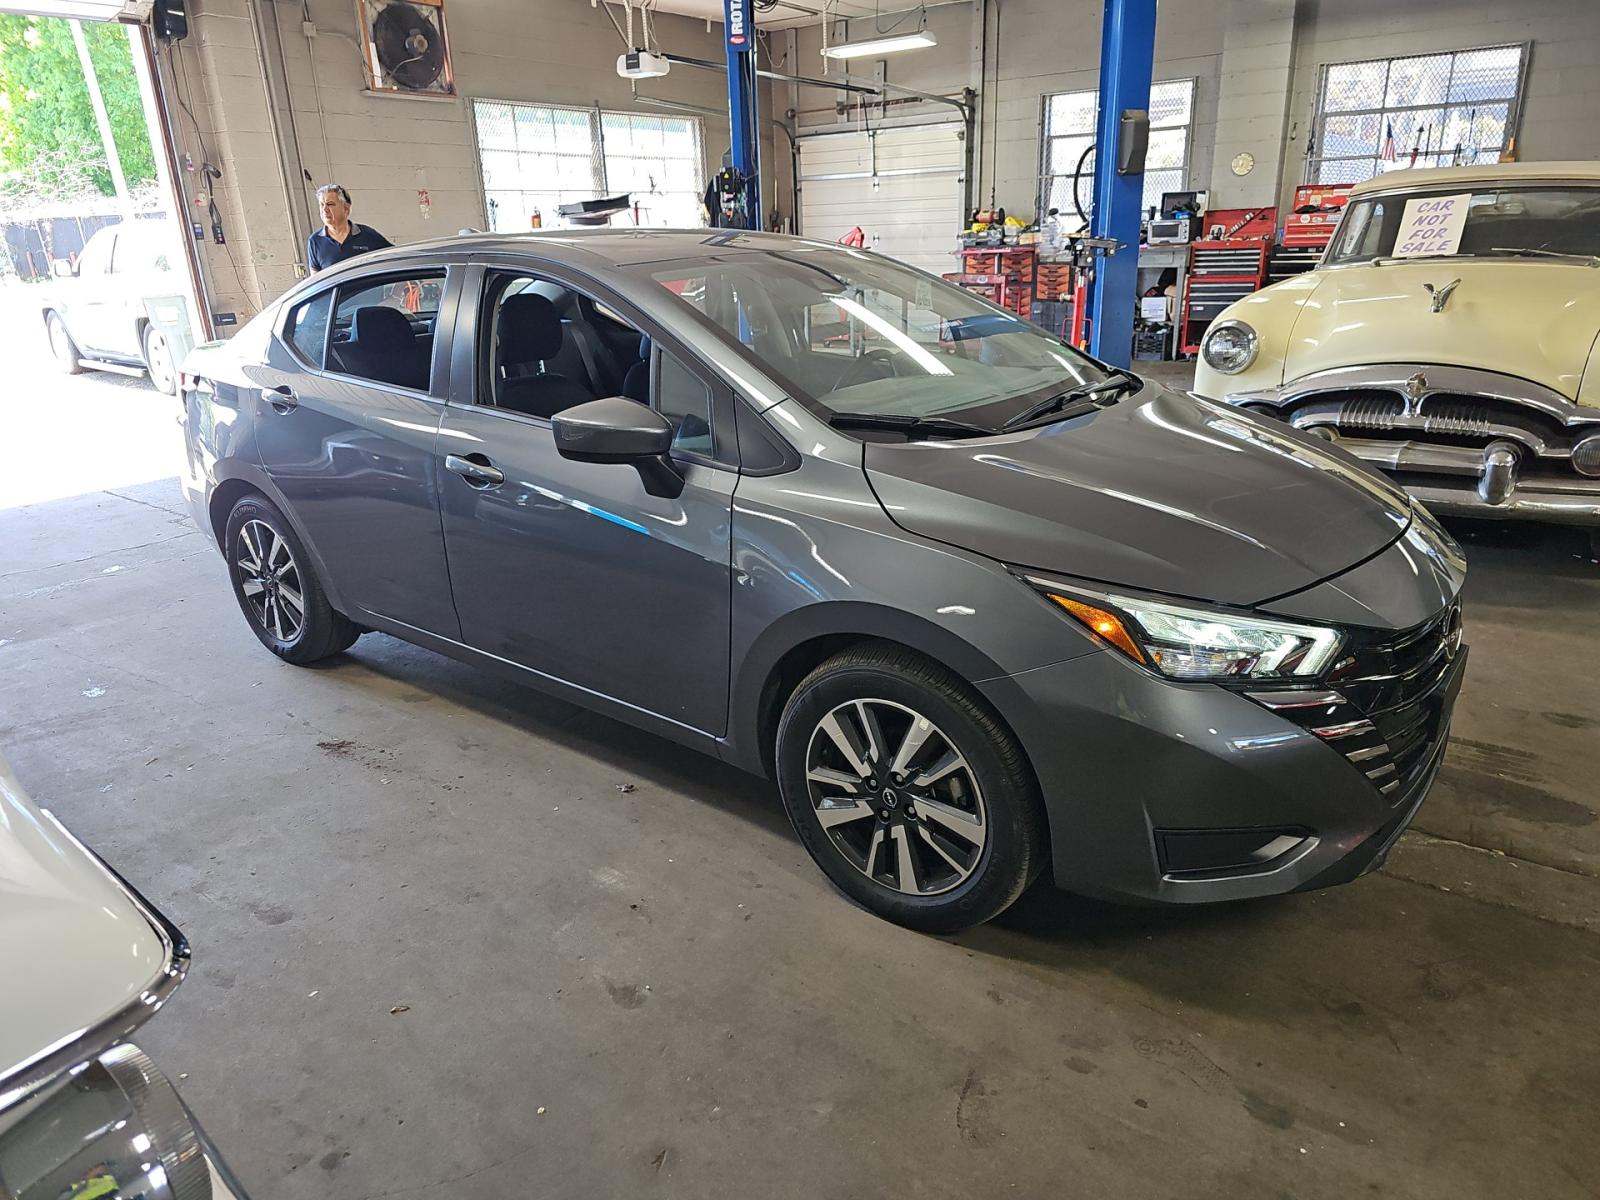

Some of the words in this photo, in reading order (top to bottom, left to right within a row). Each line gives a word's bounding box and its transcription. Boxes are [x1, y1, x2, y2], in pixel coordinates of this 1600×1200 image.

[1417, 200, 1455, 213] CAR
[1412, 213, 1453, 226] NOT
[1408, 227, 1448, 240] FOR
[1399, 240, 1453, 253] SALE
